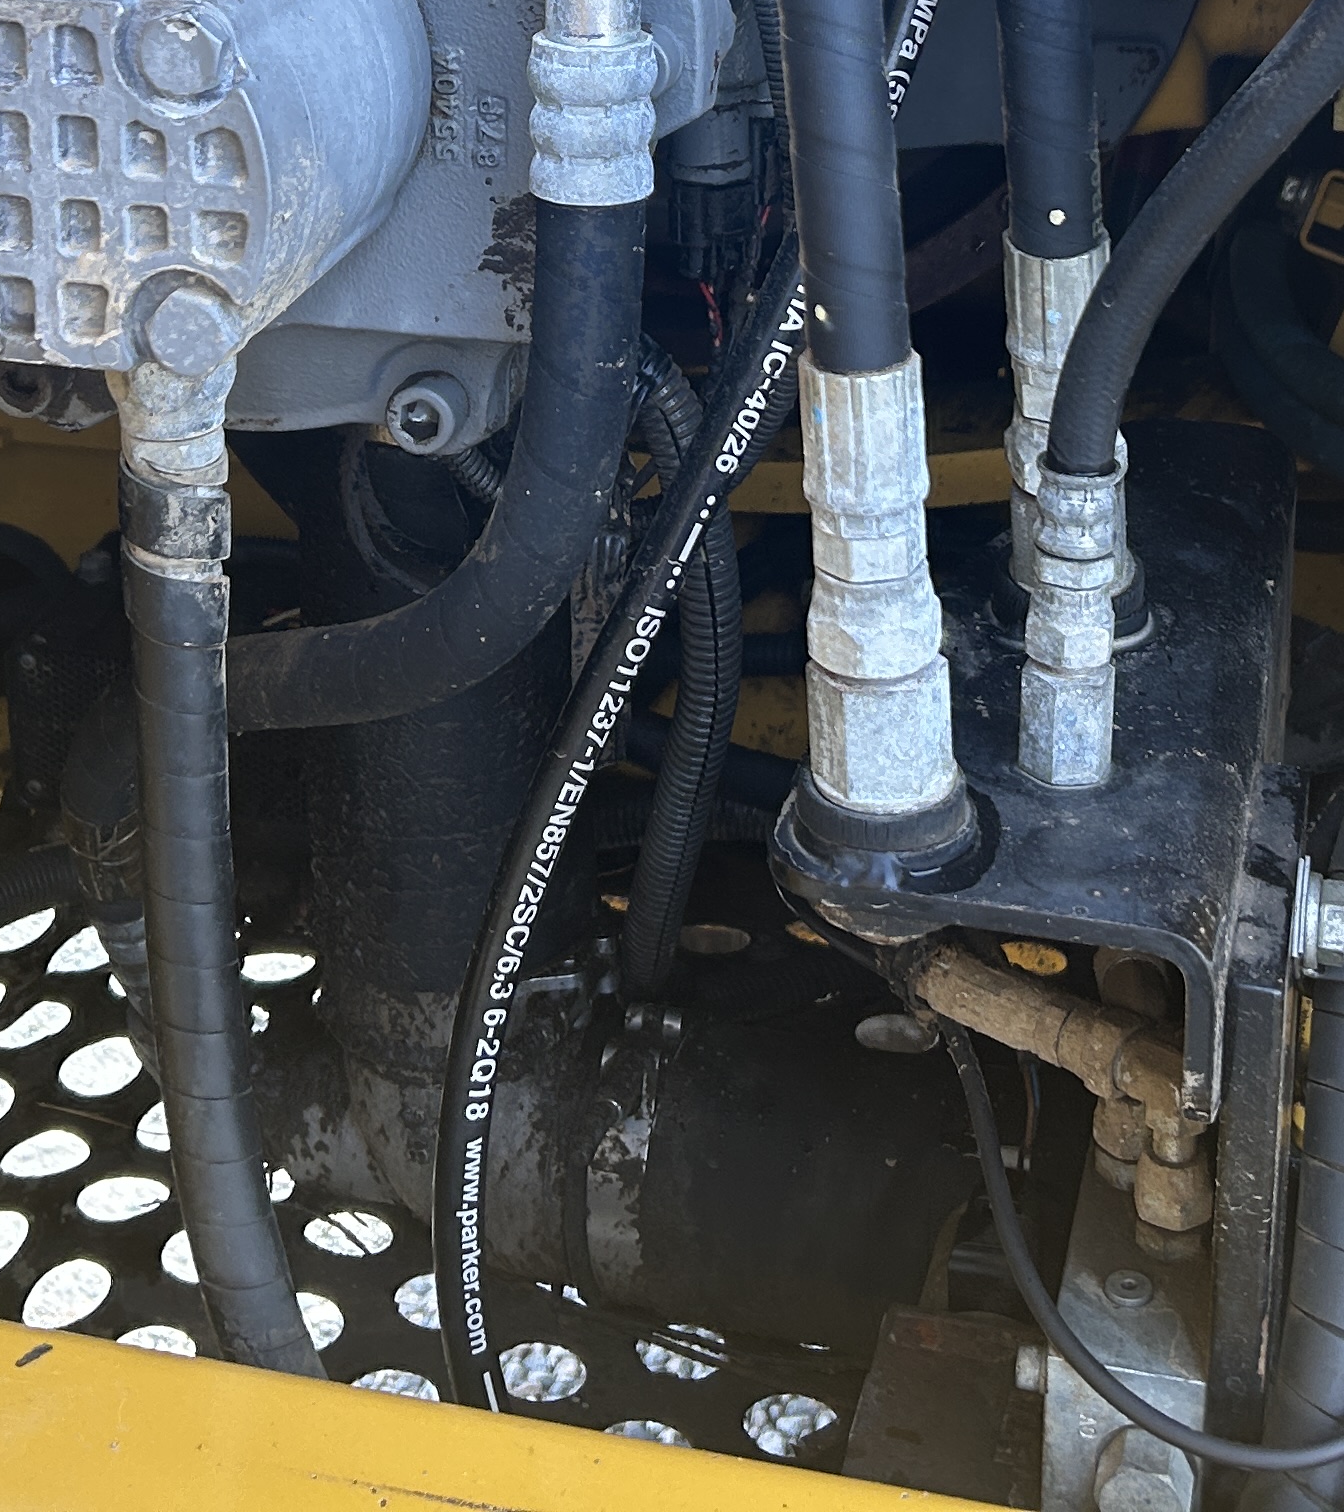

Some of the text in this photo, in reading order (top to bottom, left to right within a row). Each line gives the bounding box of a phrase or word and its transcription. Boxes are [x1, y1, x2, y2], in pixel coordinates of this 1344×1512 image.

[714, 339, 793, 475] IC-40/26
[455, 605, 667, 1356] ISO11237-1/EN857/2SC/6,3 6-2Q18 www.parker.com
